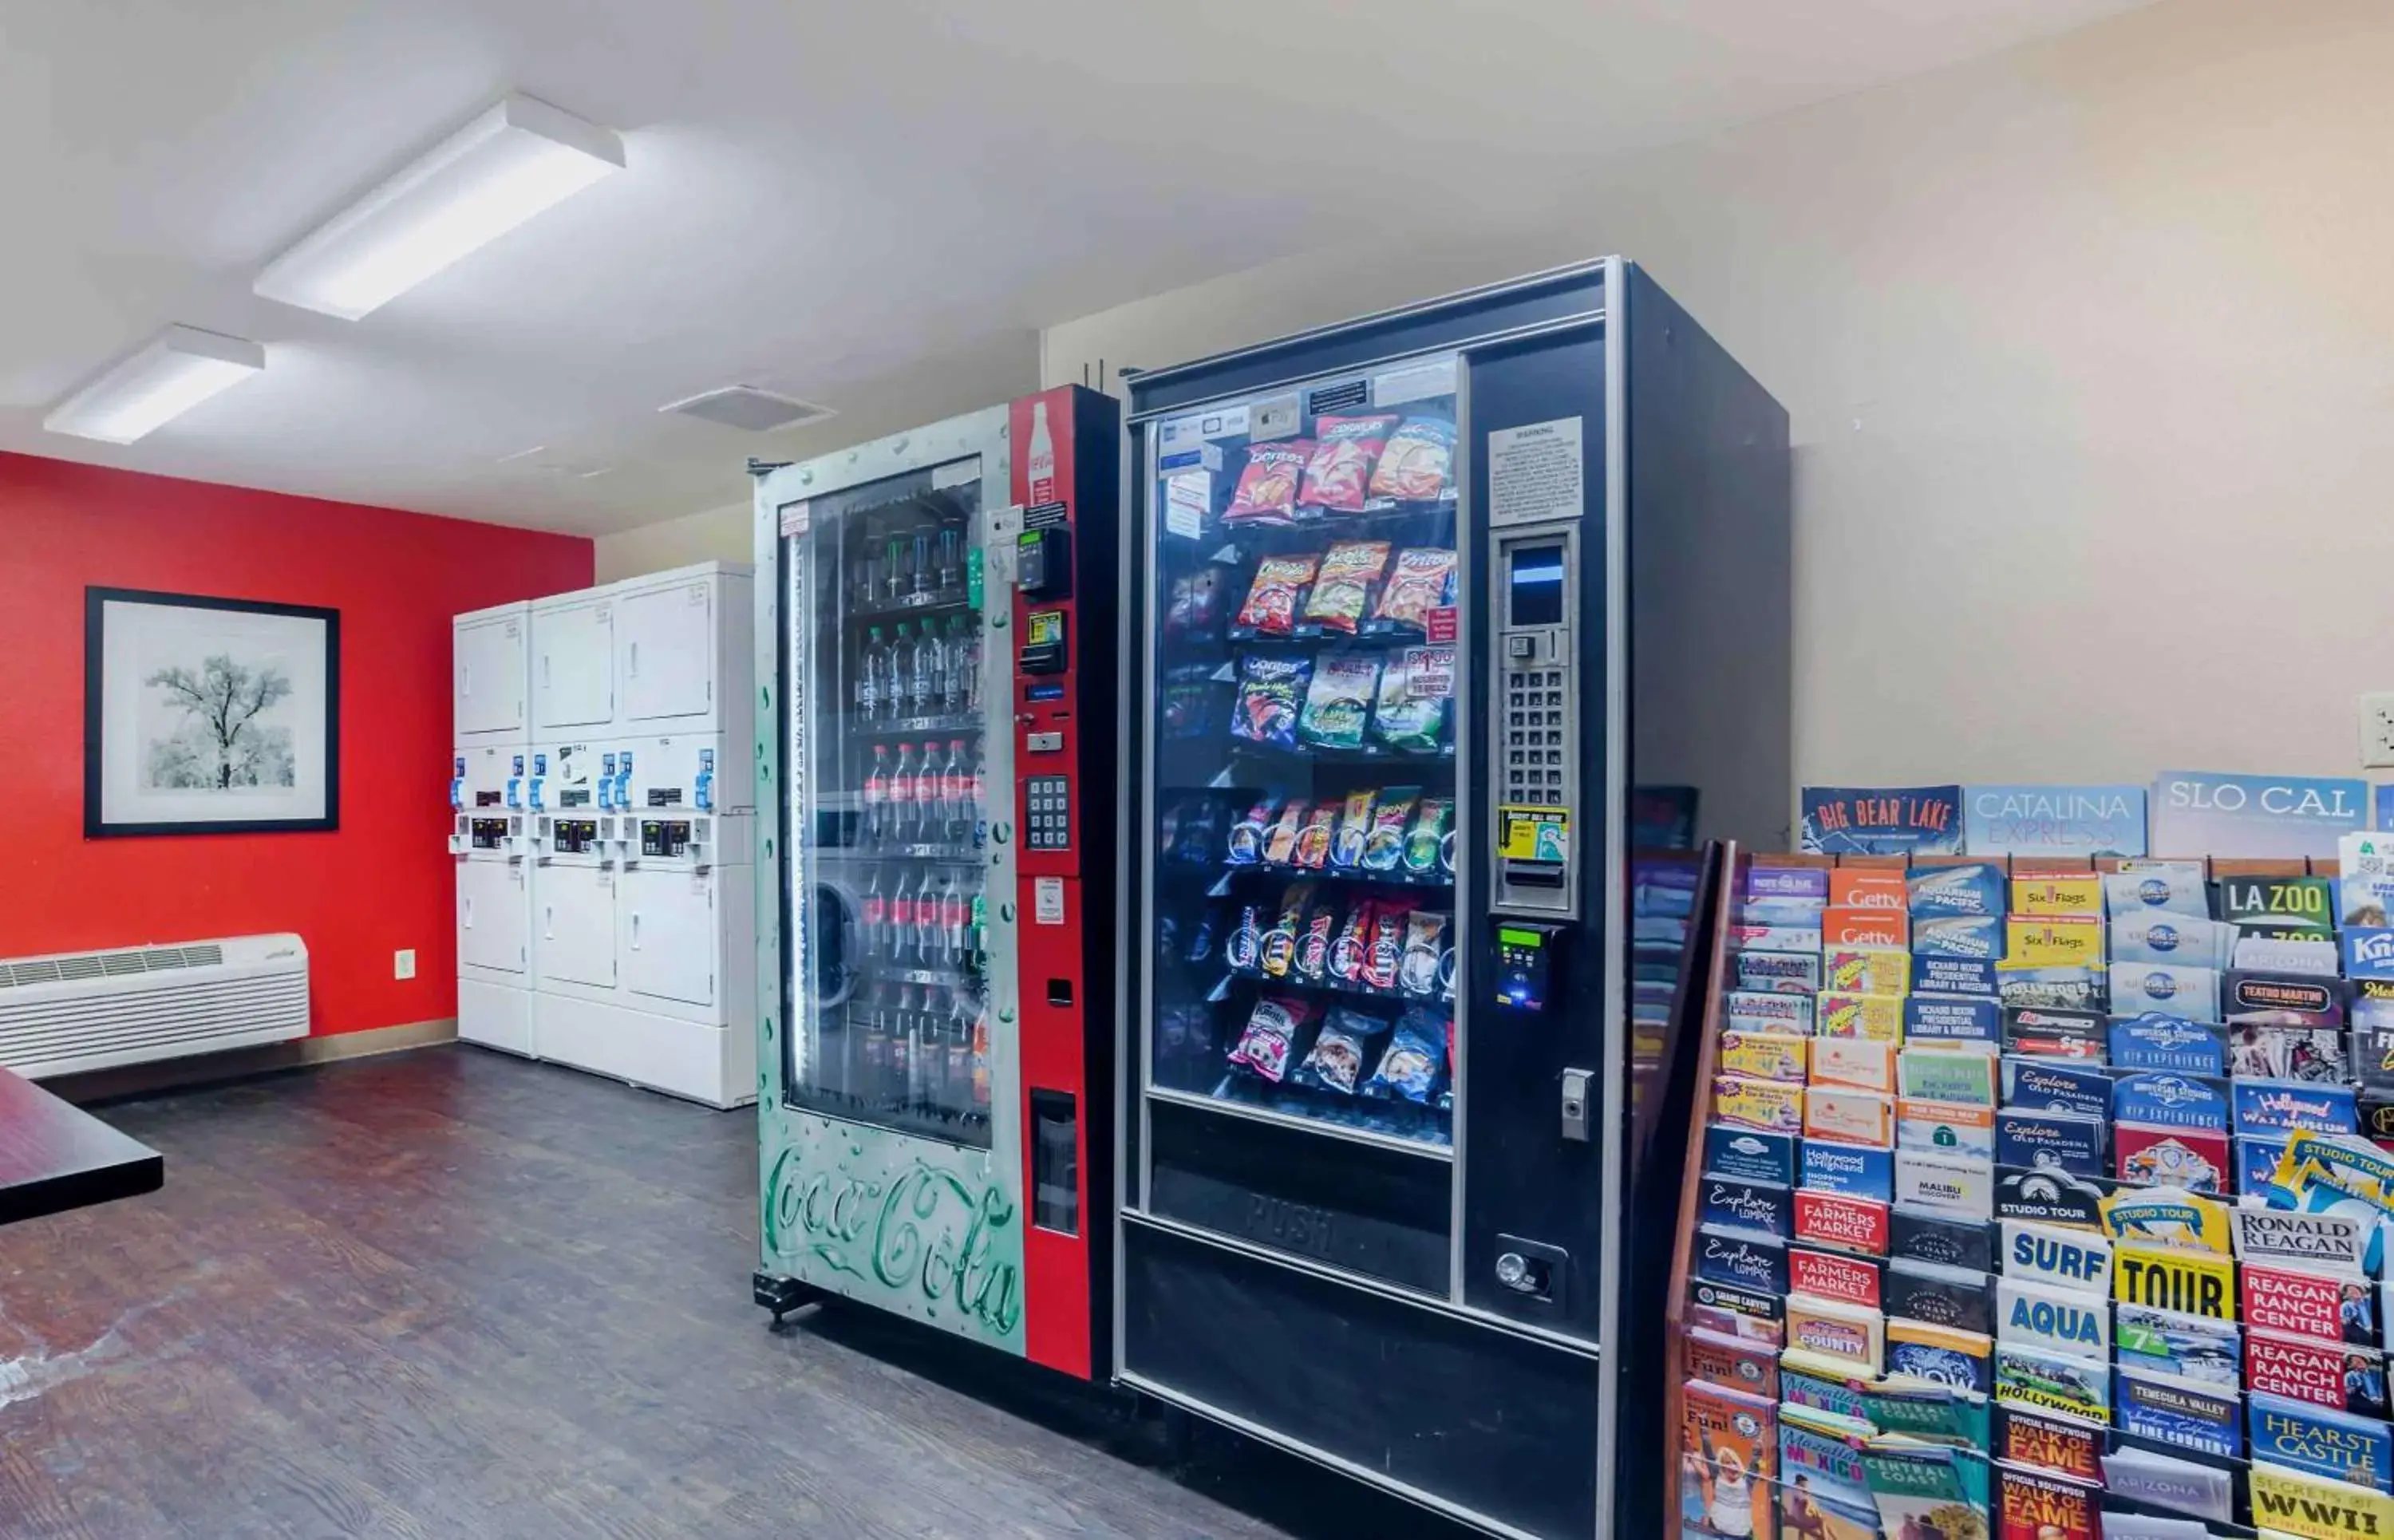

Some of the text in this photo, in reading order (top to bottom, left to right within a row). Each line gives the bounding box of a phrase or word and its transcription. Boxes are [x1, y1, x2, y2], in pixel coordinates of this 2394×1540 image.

[1250, 450, 1306, 466] Doritos
[1250, 657, 1298, 674] Doritos
[1975, 792, 2131, 820] CATALINA
[2169, 780, 2355, 818] SLO CAL
[1819, 798, 1953, 832] BIG BEAR LAKE
[1988, 819, 2116, 846] EXPRESS
[1847, 890, 1902, 909] Getty
[1918, 883, 1982, 899] AQUARIUM
[1935, 894, 1981, 909] PACIFIC
[2027, 893, 2087, 905] Six Flags
[2230, 884, 2323, 913] LA ZOO
[1841, 928, 1896, 947] Getty
[1926, 926, 1990, 950] AQUARIUM
[2024, 934, 2084, 949] Six Flags
[2353, 933, 2394, 965] Kn
[2021, 1069, 2079, 1090] Explore
[2028, 1084, 2052, 1095] OLD
[2004, 1120, 2062, 1138] Explore
[2242, 1112, 2349, 1134] WAX MUSEUM
[2012, 1134, 2089, 1149] OLD PASADENA
[2303, 1142, 2355, 1163] STUDIO
[2358, 1158, 2394, 1179] TOUR
[1710, 1183, 1778, 1213] Explore
[1919, 1181, 1961, 1194] MALIBU
[1804, 1203, 1877, 1229] FARMERS
[2000, 1203, 2088, 1219] STUDIO TOUR
[2114, 1207, 2195, 1222] STUDIO TOUR
[1807, 1218, 1874, 1239] MARKET
[2239, 1214, 2351, 1238] RONALD
[1705, 1237, 1774, 1269] Explore
[2243, 1231, 2353, 1254] REAGAN
[2013, 1233, 2107, 1282] SURF
[1797, 1261, 1872, 1285] FARMERS
[1802, 1275, 1867, 1297] MARKET
[2122, 1259, 2222, 1319] TOUR
[2248, 1276, 2337, 1304] REAGAN
[2254, 1293, 2333, 1319] RANCH
[2010, 1297, 2102, 1347] AQUA
[2250, 1309, 2337, 1337] CENTER
[1800, 1333, 1864, 1355] COUNTY
[2250, 1343, 2341, 1373] REAGAN
[2255, 1360, 2337, 1388] RANCH
[1999, 1384, 2103, 1421] HOLLYWOOD
[2134, 1385, 2226, 1416] TEMECULA VALLEY
[2253, 1376, 2341, 1405] CENTER
[1867, 1398, 1950, 1416] CENTRAL
[1882, 1408, 1940, 1424] COAST
[1688, 1409, 1728, 1432] Fun!
[2009, 1413, 2043, 1429] OFFICIAL
[2008, 1421, 2093, 1451] WALK OF
[2128, 1420, 2233, 1457] WINE COUNTRY
[2266, 1413, 2380, 1454] HEARST
[1786, 1443, 1863, 1482] MEXICO
[2009, 1434, 2095, 1474] FAME
[2275, 1435, 2376, 1471] CASTLE
[1865, 1456, 1948, 1479] CENTRAL
[1880, 1471, 1939, 1485] COAST
[2002, 1471, 2036, 1487] OFFICIAL
[2001, 1479, 2088, 1511] WALK OF
[2116, 1476, 2200, 1497] ARIZONA
[2255, 1476, 2375, 1509] SECRETS OF
[2003, 1493, 2090, 1533] FAME
[2256, 1490, 2380, 1536] WWII
